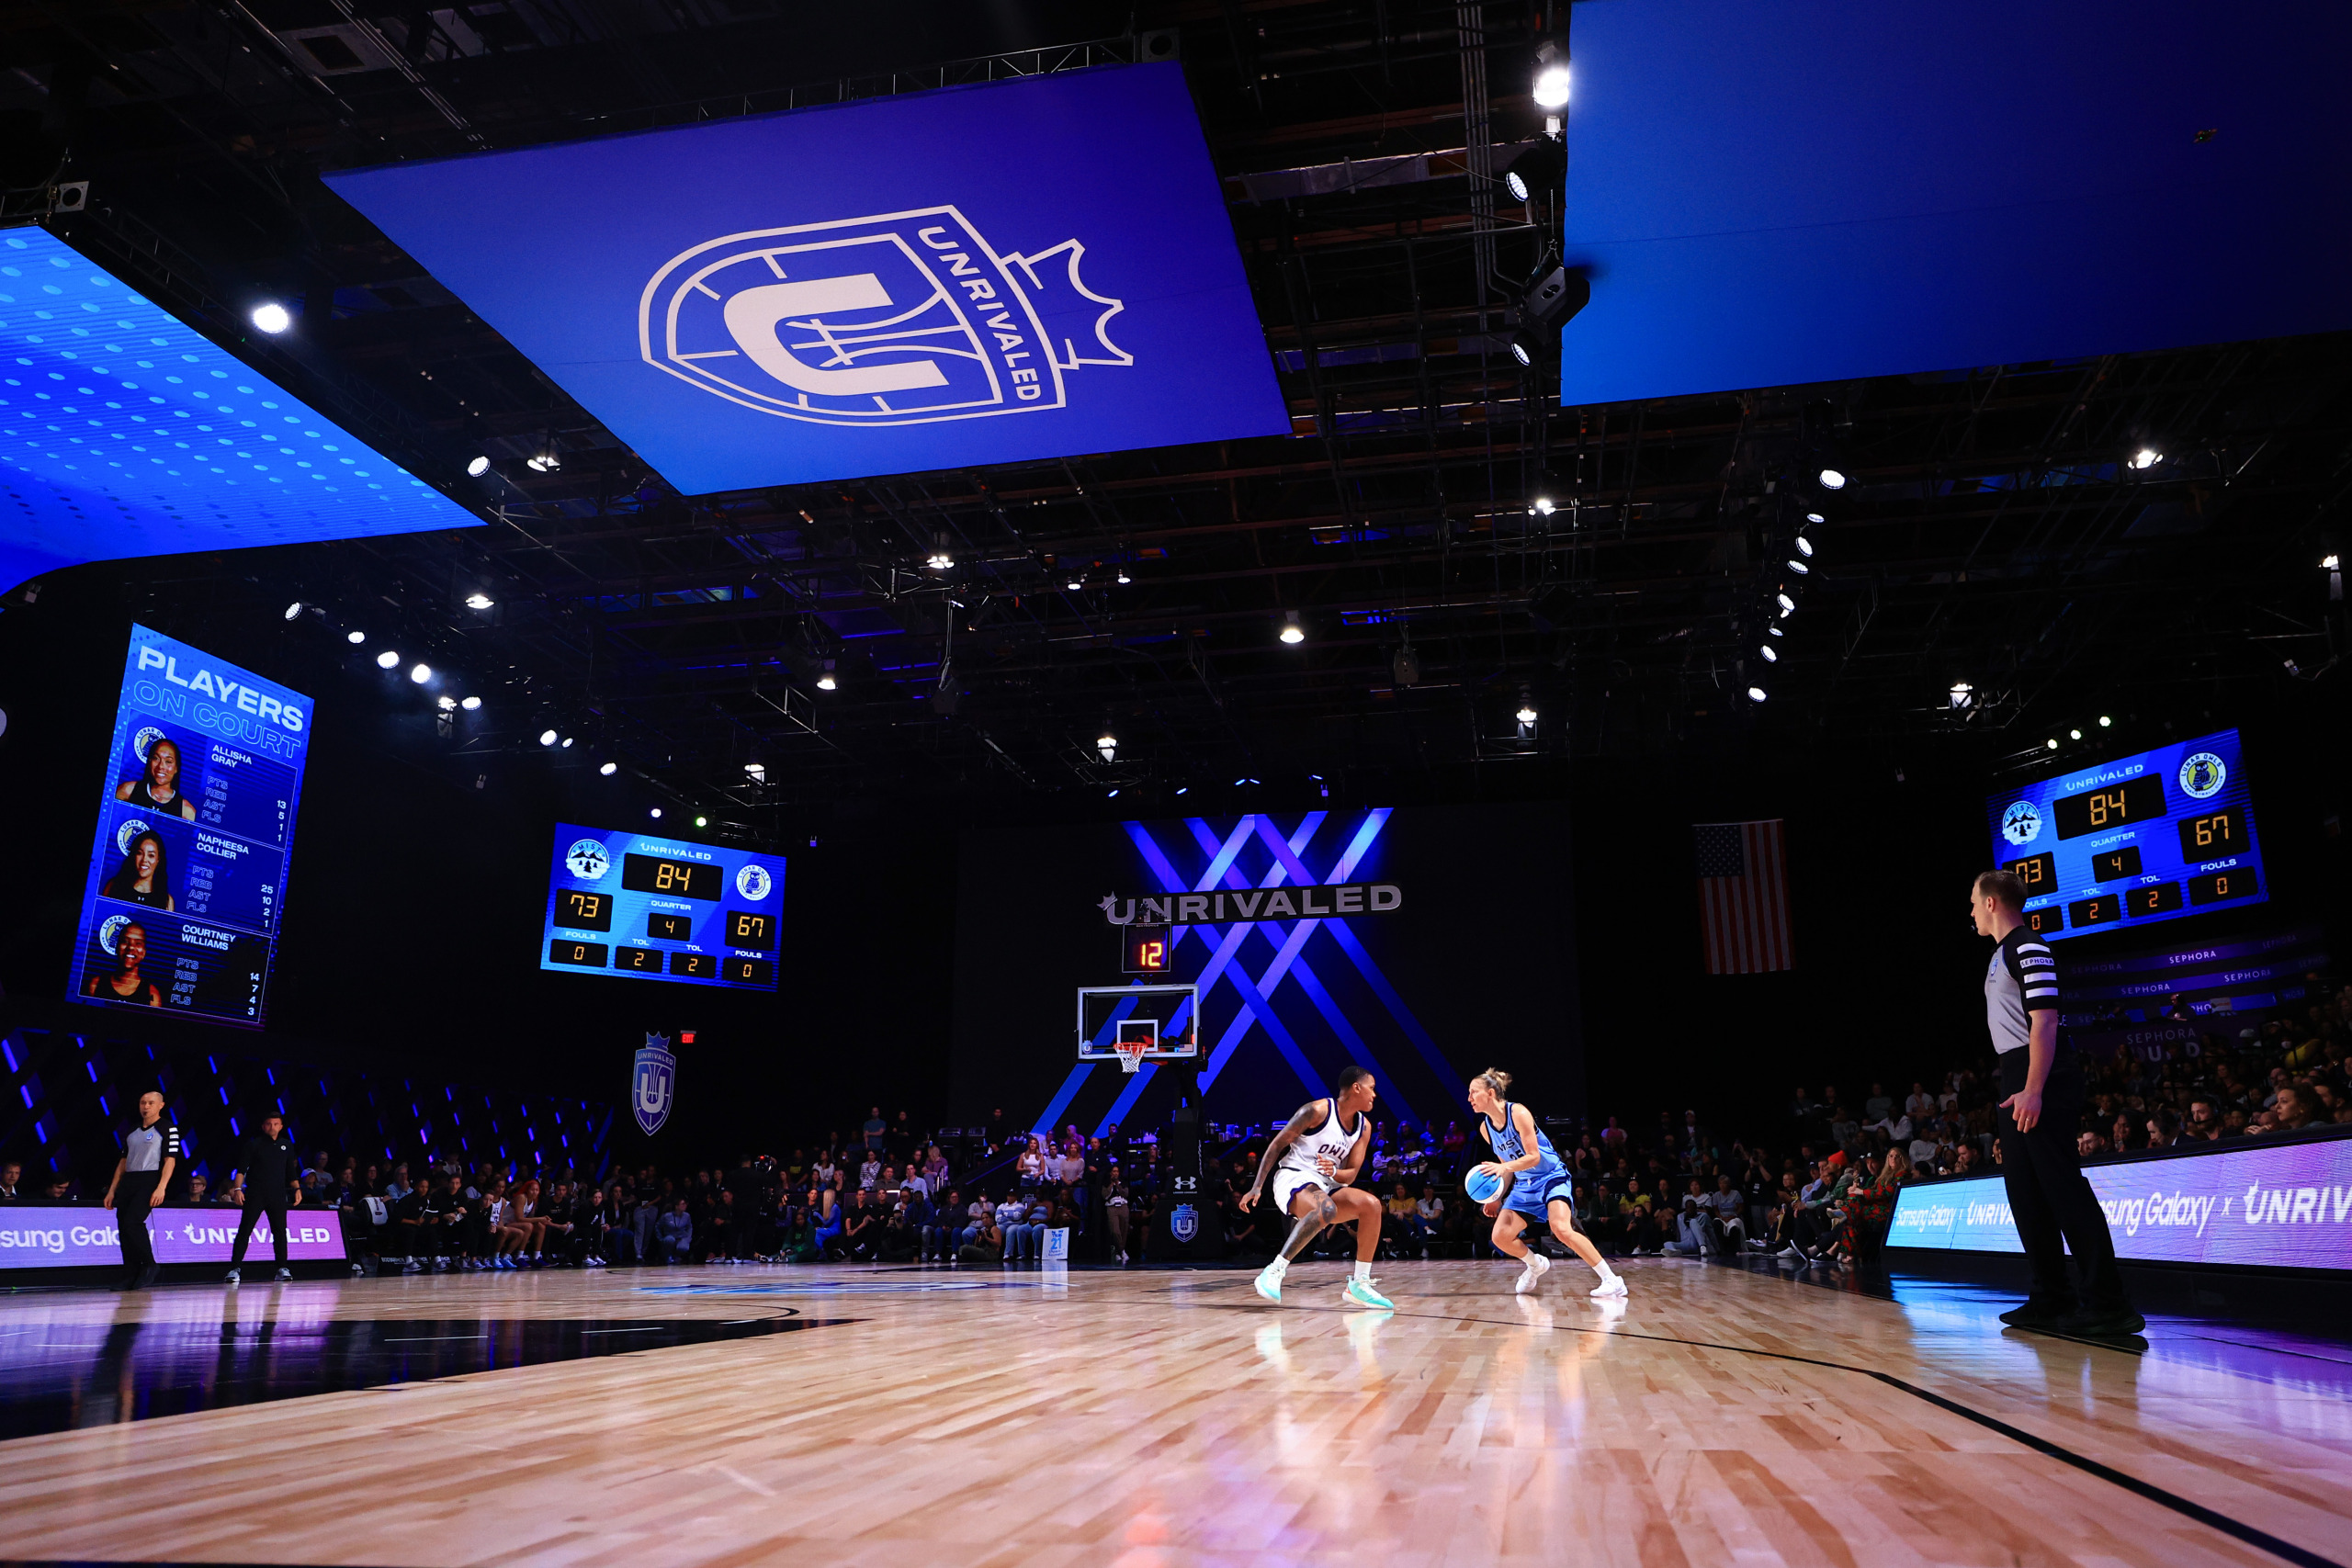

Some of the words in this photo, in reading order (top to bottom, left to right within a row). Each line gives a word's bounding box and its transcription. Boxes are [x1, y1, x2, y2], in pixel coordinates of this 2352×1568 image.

[917, 226, 1041, 400] UNRIVALED
[138, 645, 304, 732] PLAYERS
[133, 679, 187, 716] ON
[193, 702, 301, 759] COURT
[137, 728, 154, 739] LUNAR
[210, 753, 237, 769] GRAY
[212, 745, 253, 765] ALLISHA
[2181, 755, 2200, 777] LUNAR
[207, 775, 229, 789] PTS
[2065, 764, 2143, 791] UNRIVALED
[205, 787, 227, 801] REB
[203, 799, 226, 813] AST
[277, 799, 287, 809] 13
[2009, 805, 2030, 817] MIST
[2090, 789, 2126, 826] 84
[201, 810, 221, 824] FLS
[277, 811, 285, 819] 5
[120, 821, 138, 833] LUNAR
[278, 822, 284, 831] 1
[2196, 815, 2229, 846] 67
[198, 832, 250, 855] NAPHEESA
[277, 833, 282, 842] 1
[2090, 831, 2135, 848] QUARTER
[196, 841, 237, 861] COLLIER
[578, 842, 602, 852] MIST
[640, 842, 712, 861] UNRIVALED
[2111, 856, 2121, 872] 4
[2200, 858, 2237, 872] FOULS
[192, 864, 214, 879] PTS
[655, 863, 691, 891] 84
[739, 866, 756, 878] LUNAR
[2016, 859, 2042, 884] 73
[190, 876, 212, 891] REB
[2140, 874, 2160, 885] TOL
[2217, 877, 2228, 895] 0
[187, 888, 211, 902] AST
[261, 884, 274, 894] 25
[2081, 886, 2100, 897] TOL
[186, 899, 207, 913] FLS
[262, 896, 272, 905] 10
[571, 894, 599, 918] 73
[650, 900, 691, 911] QUARTER
[1097, 884, 1402, 925] UNRIVALED
[2024, 898, 2048, 908] OULS
[2148, 891, 2158, 908] 2
[263, 908, 270, 917] 2
[2089, 903, 2098, 919] 2
[103, 916, 121, 930] LUNAR
[264, 919, 268, 928] 1
[665, 920, 674, 933] 4
[737, 916, 763, 938] 67
[2031, 914, 2041, 931] 0
[182, 924, 236, 942] COURTNEY
[565, 931, 596, 940] FOULS
[181, 933, 229, 952] WILLIAMS
[632, 938, 650, 946] TOL
[686, 943, 703, 952] TOL
[573, 946, 584, 960] 0
[634, 953, 644, 966] 2
[735, 950, 762, 959] FOULS
[1141, 942, 1162, 967] 12
[2169, 951, 2217, 964] SEPHORA
[176, 957, 199, 971] PTS
[688, 958, 698, 972] 2
[2021, 958, 2053, 966] SEPHORA
[174, 969, 198, 983] REB
[250, 972, 260, 982] 14
[742, 964, 752, 977] 0
[172, 981, 196, 994] AST
[251, 984, 258, 993] 7
[2120, 983, 2171, 996] SEPHORA
[170, 992, 192, 1006] FLS
[248, 996, 256, 1004] 4
[247, 1007, 254, 1016] 3
[682, 1033, 695, 1043] EXIT
[2127, 1027, 2197, 1044] SEPHORA
[638, 1052, 673, 1066] UNRIVALED
[640, 1073, 666, 1113] U
[1318, 1144, 1345, 1161] OWL
[1895, 1207, 1928, 1233] Samsung
[1928, 1204, 1957, 1233] Galaxy
[1966, 1198, 2016, 1225] UNRIVA
[2145, 1190, 2216, 1237] Galaxy
[2221, 1198, 2231, 1216] x
[165, 1230, 175, 1240] x
[1050, 1237, 1062, 1250] 21
